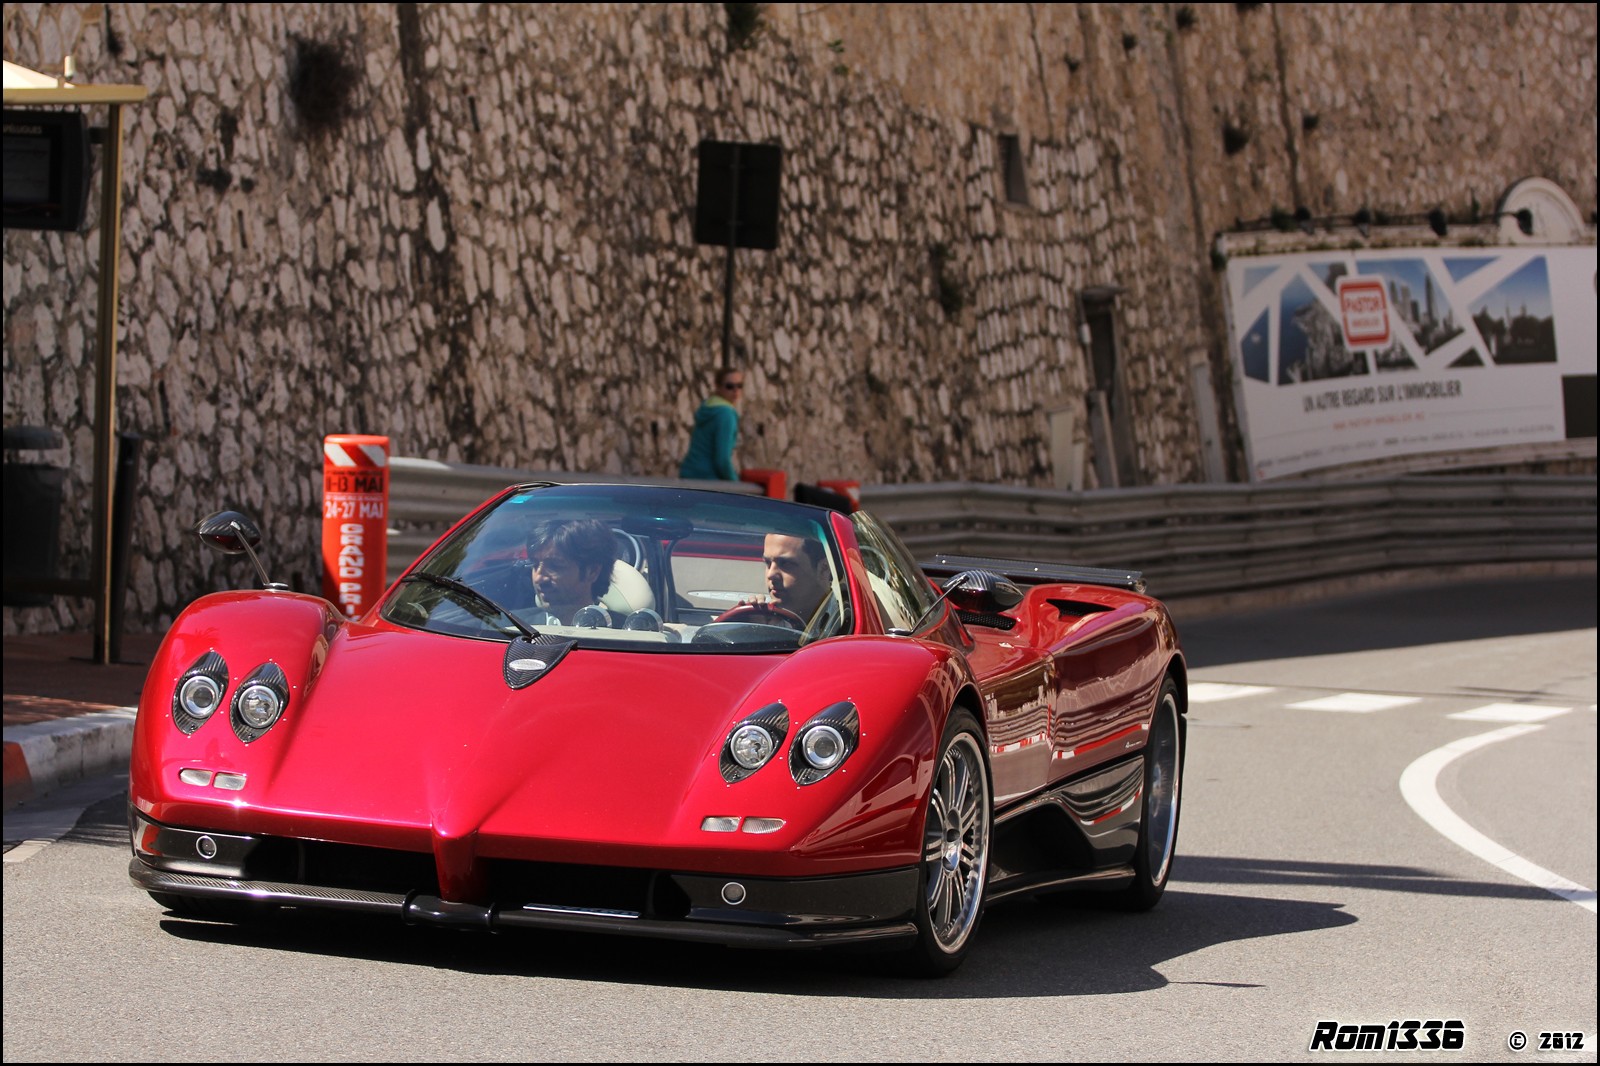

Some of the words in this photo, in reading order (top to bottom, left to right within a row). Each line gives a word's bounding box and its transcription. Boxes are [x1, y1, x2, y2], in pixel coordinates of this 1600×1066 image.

[1316, 390, 1340, 410] AUTRE
[1341, 386, 1375, 407] REGARD
[1377, 384, 1395, 403] SUR
[354, 477, 383, 491] MAI
[325, 500, 355, 518] 24-27
[359, 500, 384, 519] MAI
[339, 523, 364, 578] GRAND
